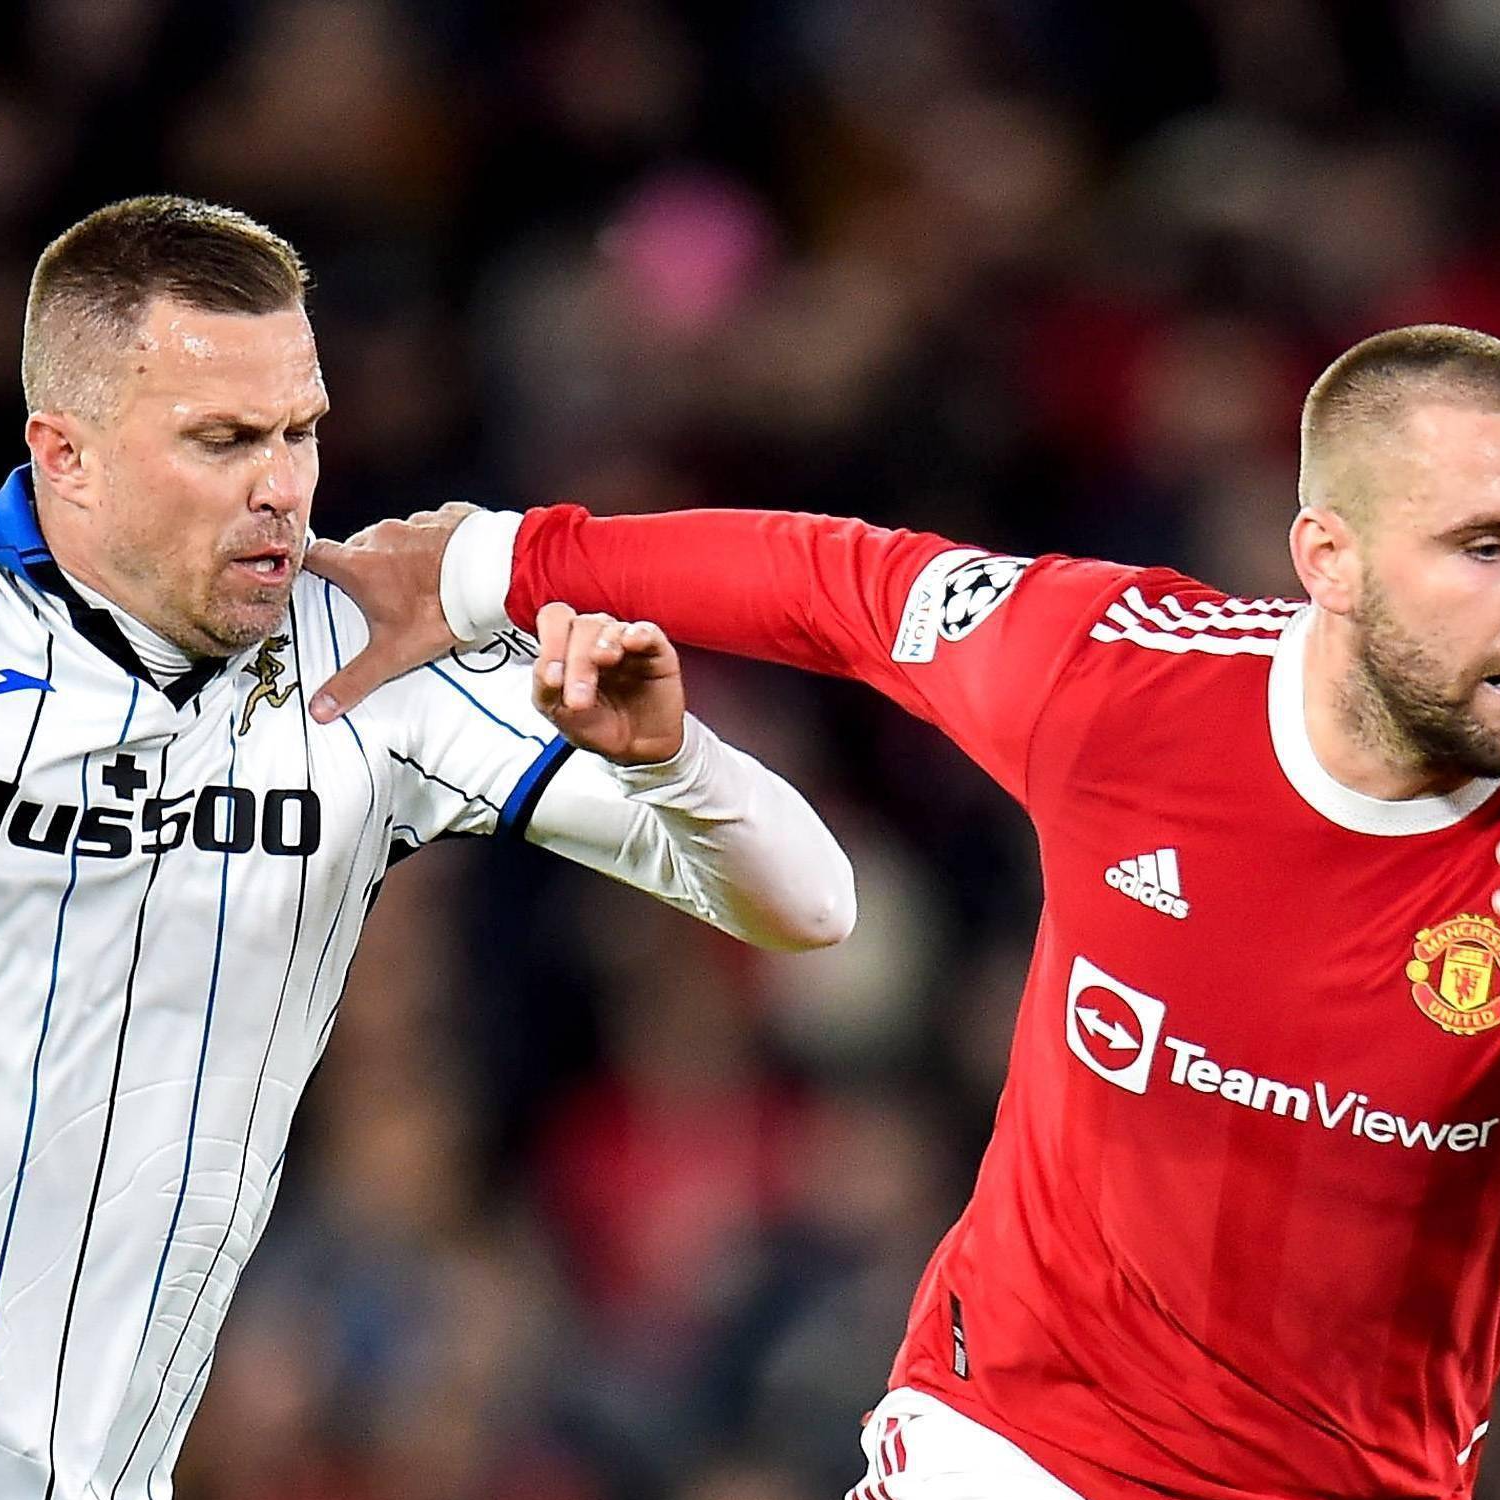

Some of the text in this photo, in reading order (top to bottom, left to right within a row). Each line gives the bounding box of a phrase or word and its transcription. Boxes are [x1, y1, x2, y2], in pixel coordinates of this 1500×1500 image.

[1105, 867, 1189, 919] adidas
[1428, 1001, 1495, 1026] UNITED
[1165, 1036, 1499, 1152] TeamViewer
